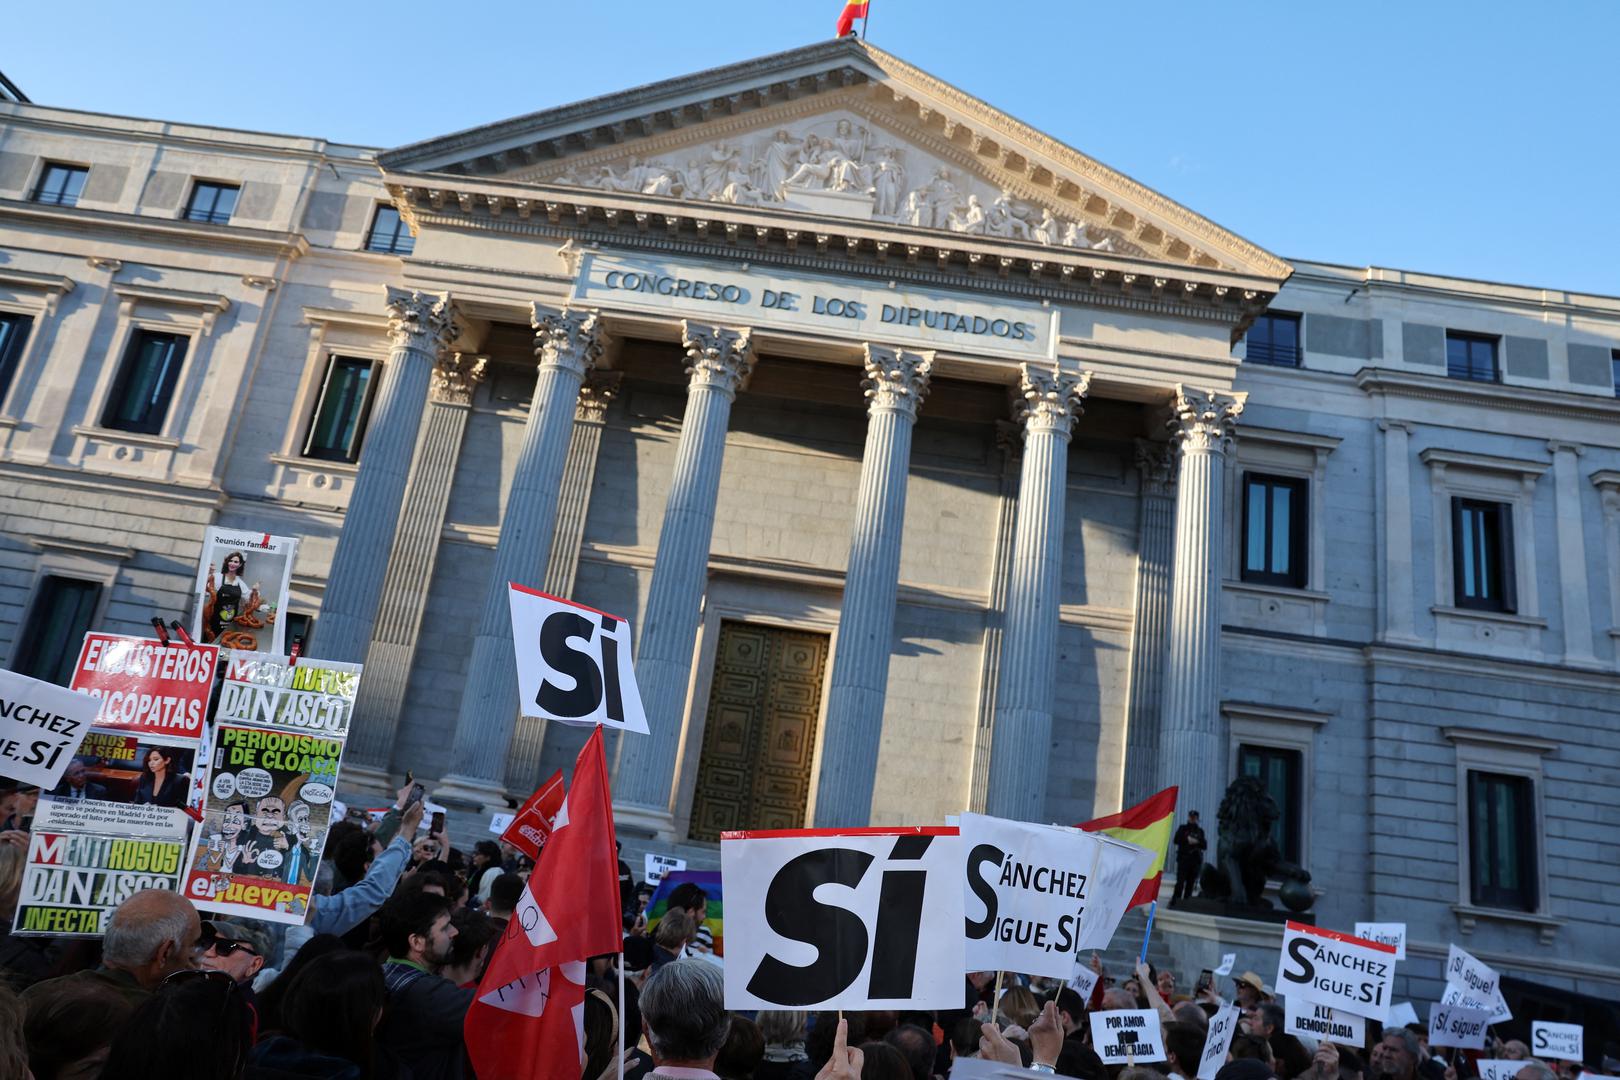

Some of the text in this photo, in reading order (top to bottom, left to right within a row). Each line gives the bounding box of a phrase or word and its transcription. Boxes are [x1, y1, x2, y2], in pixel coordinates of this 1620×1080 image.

[605, 270, 1026, 339] CONGRESO DE LOS DIPUTADOS
[215, 536, 245, 547] Reunión
[77, 686, 200, 731] ICÓPATAS
[279, 693, 345, 731] ASCO
[95, 747, 136, 761] SERIE
[224, 728, 342, 758] PERIODISMO
[230, 747, 337, 777] DE CLOACA
[50, 810, 81, 818] superado
[115, 803, 145, 811] escudero
[118, 810, 141, 818] Madrid
[31, 832, 181, 875] MENTIROSOS
[28, 866, 96, 907] DAN
[23, 906, 98, 933] INFECTA
[1464, 967, 1495, 996] sigue!
[1105, 1015, 1146, 1029] POR AMOR
[1314, 1005, 1320, 1019] A
[1450, 1017, 1486, 1039] sigue!
